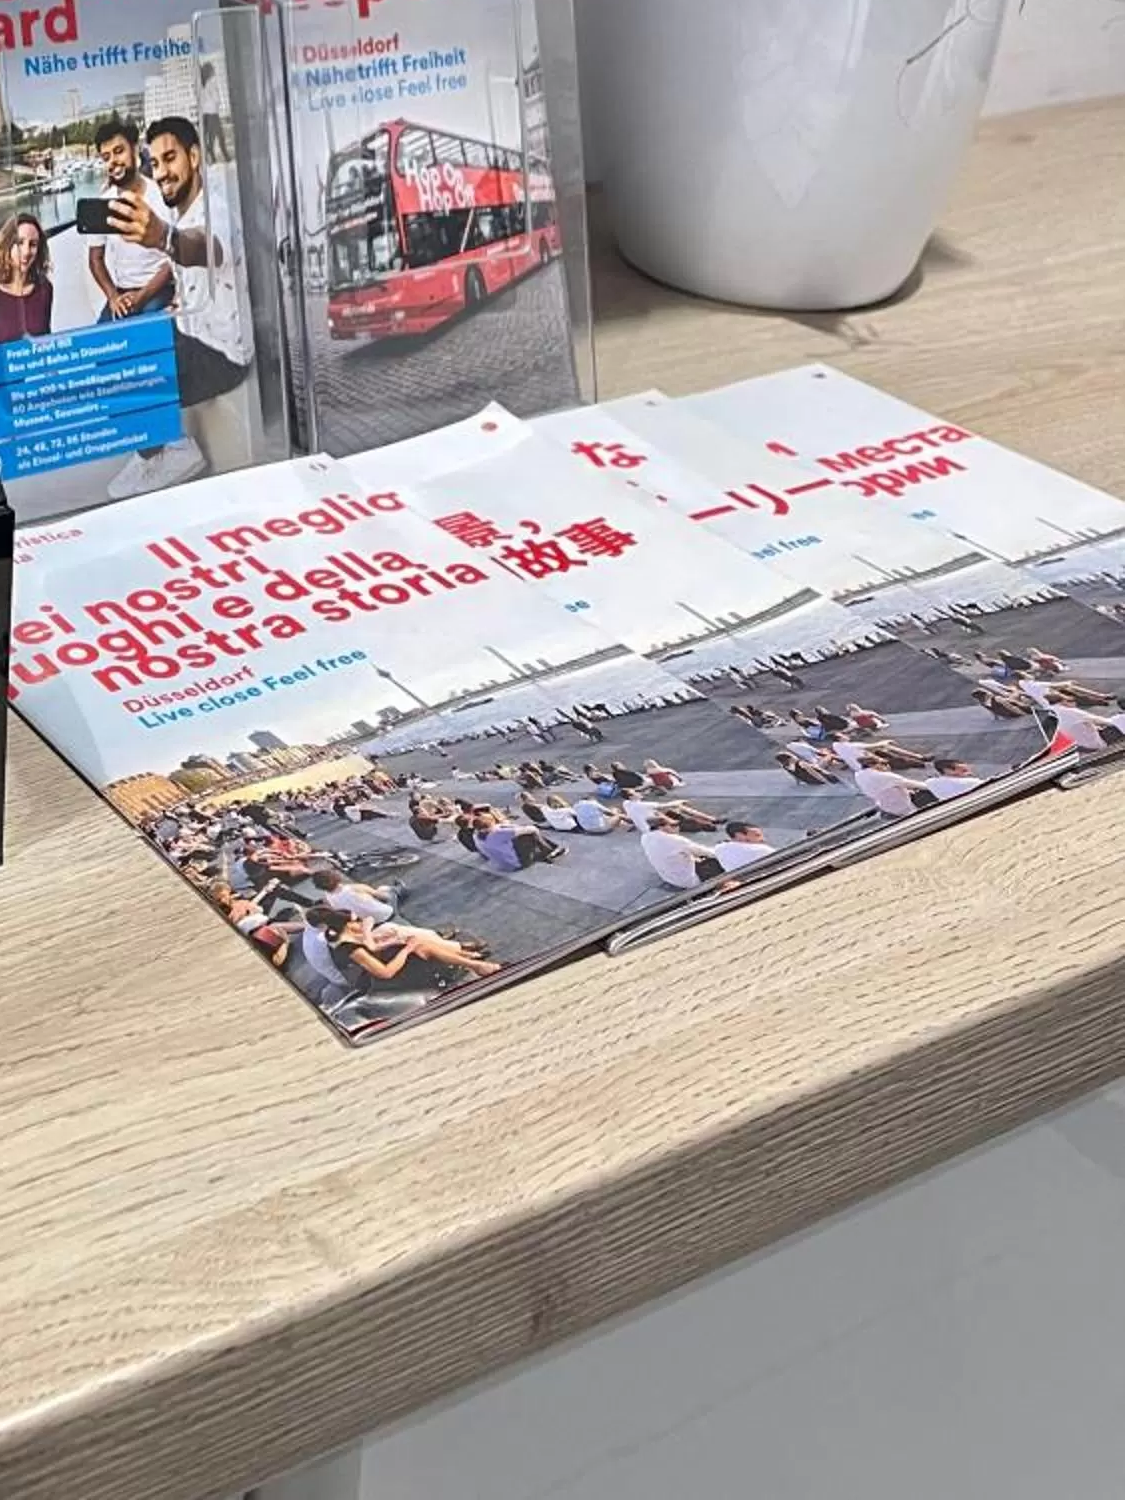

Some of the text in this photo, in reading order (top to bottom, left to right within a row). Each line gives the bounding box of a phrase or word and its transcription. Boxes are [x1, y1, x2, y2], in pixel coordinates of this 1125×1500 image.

[24, 54, 78, 77] Nähe
[82, 44, 129, 69] trifft
[302, 32, 400, 64] Düsseldorf
[357, 59, 399, 79] trifft
[402, 46, 467, 73] Freiheit
[308, 92, 347, 112] Live
[398, 76, 432, 97] Feel
[436, 72, 468, 91] free
[816, 425, 973, 473] места
[146, 490, 407, 569] Il meglio
[490, 517, 639, 582] 故事
[8, 546, 427, 698] uoghi e della
[10, 547, 276, 653] ei nostri
[90, 558, 490, 694] nostra storia
[123, 664, 256, 714] Düsseldorf
[137, 648, 368, 729] Live close Feel free
